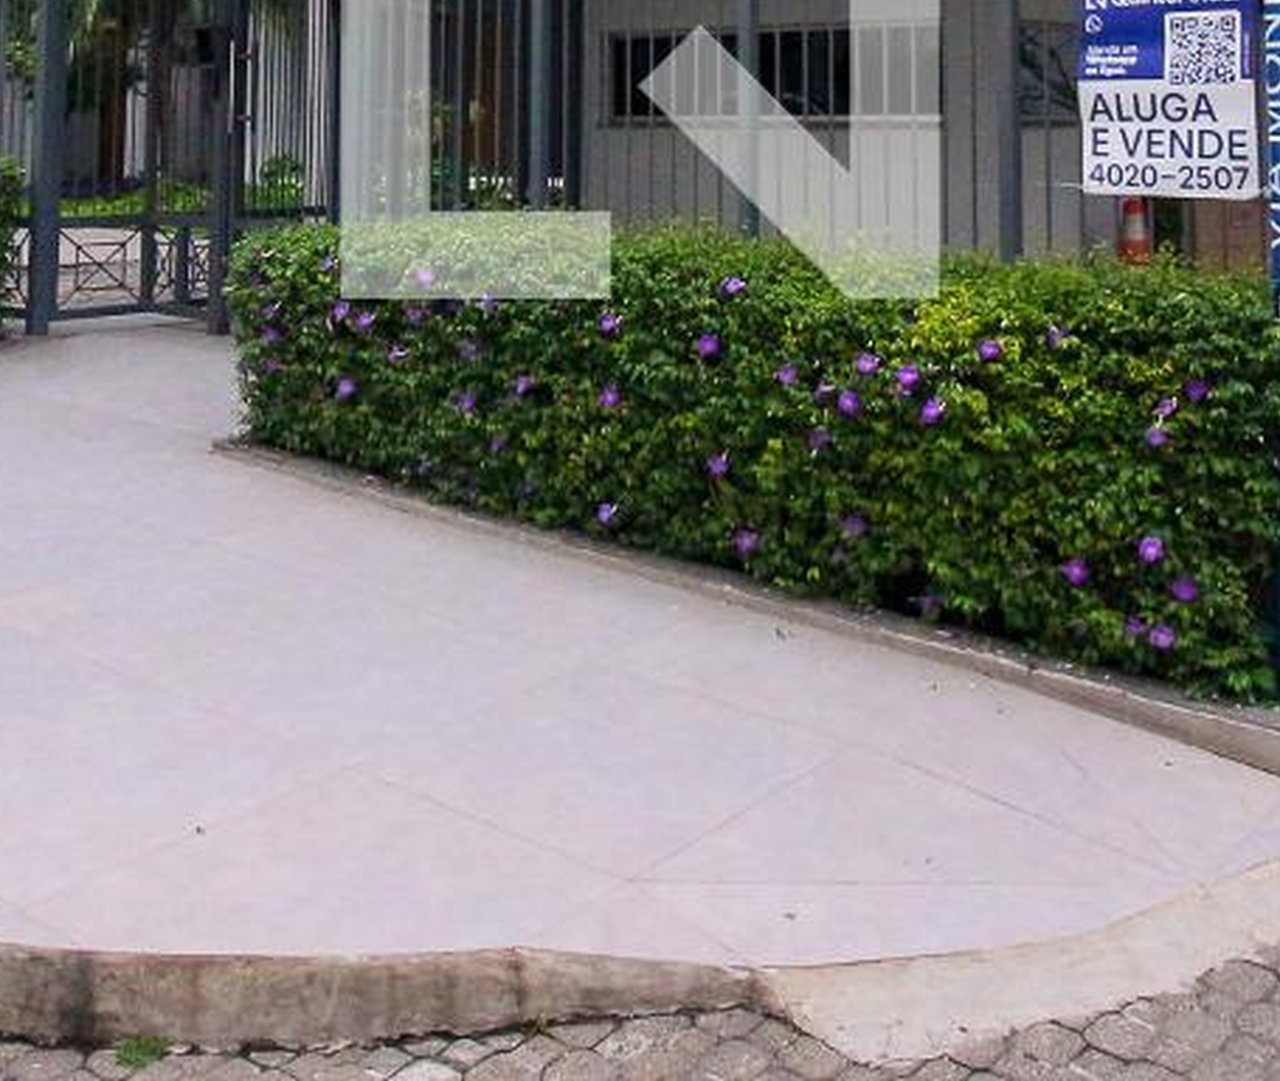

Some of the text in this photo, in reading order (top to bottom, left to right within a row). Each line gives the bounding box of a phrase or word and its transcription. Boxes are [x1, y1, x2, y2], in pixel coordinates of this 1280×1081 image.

[1089, 92, 1219, 123] ALUGA
[1091, 127, 1250, 161] E VENDE
[1088, 162, 1251, 191] 4020-2507
